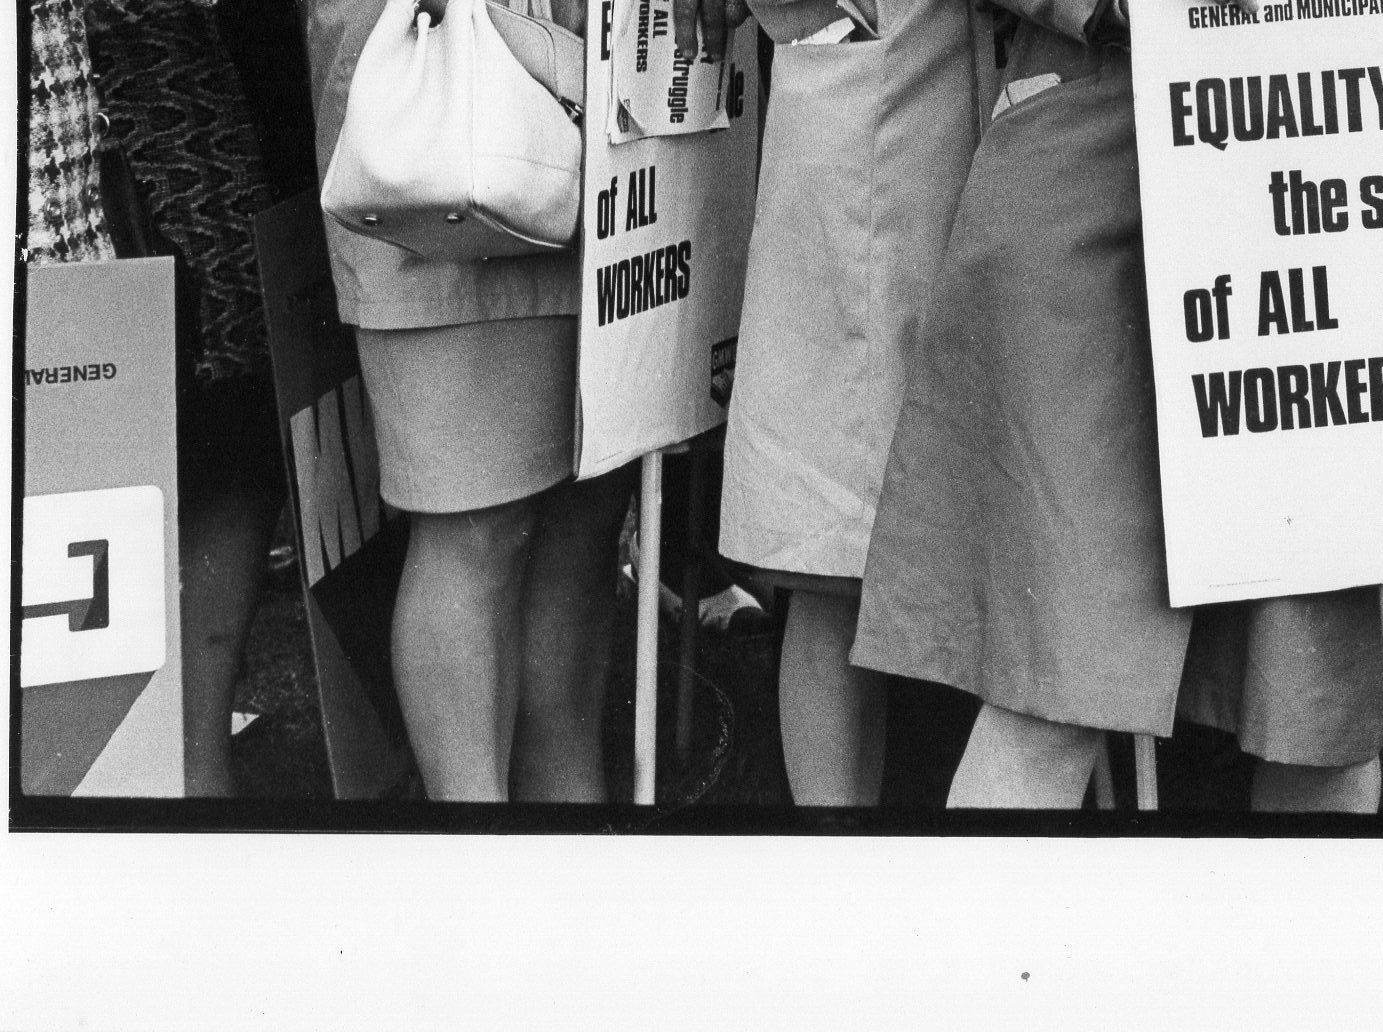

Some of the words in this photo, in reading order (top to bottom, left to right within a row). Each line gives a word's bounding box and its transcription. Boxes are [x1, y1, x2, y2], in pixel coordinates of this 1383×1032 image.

[653, 10, 668, 39] ALL
[1188, 4, 1260, 29] GENERAL
[1264, 0, 1292, 22] and
[597, 176, 617, 239] of
[626, 166, 657, 231] ALL
[1269, 170, 1348, 235] the
[597, 240, 691, 327] WORKERS
[1184, 275, 1232, 342] of
[1258, 266, 1338, 336] ALL
